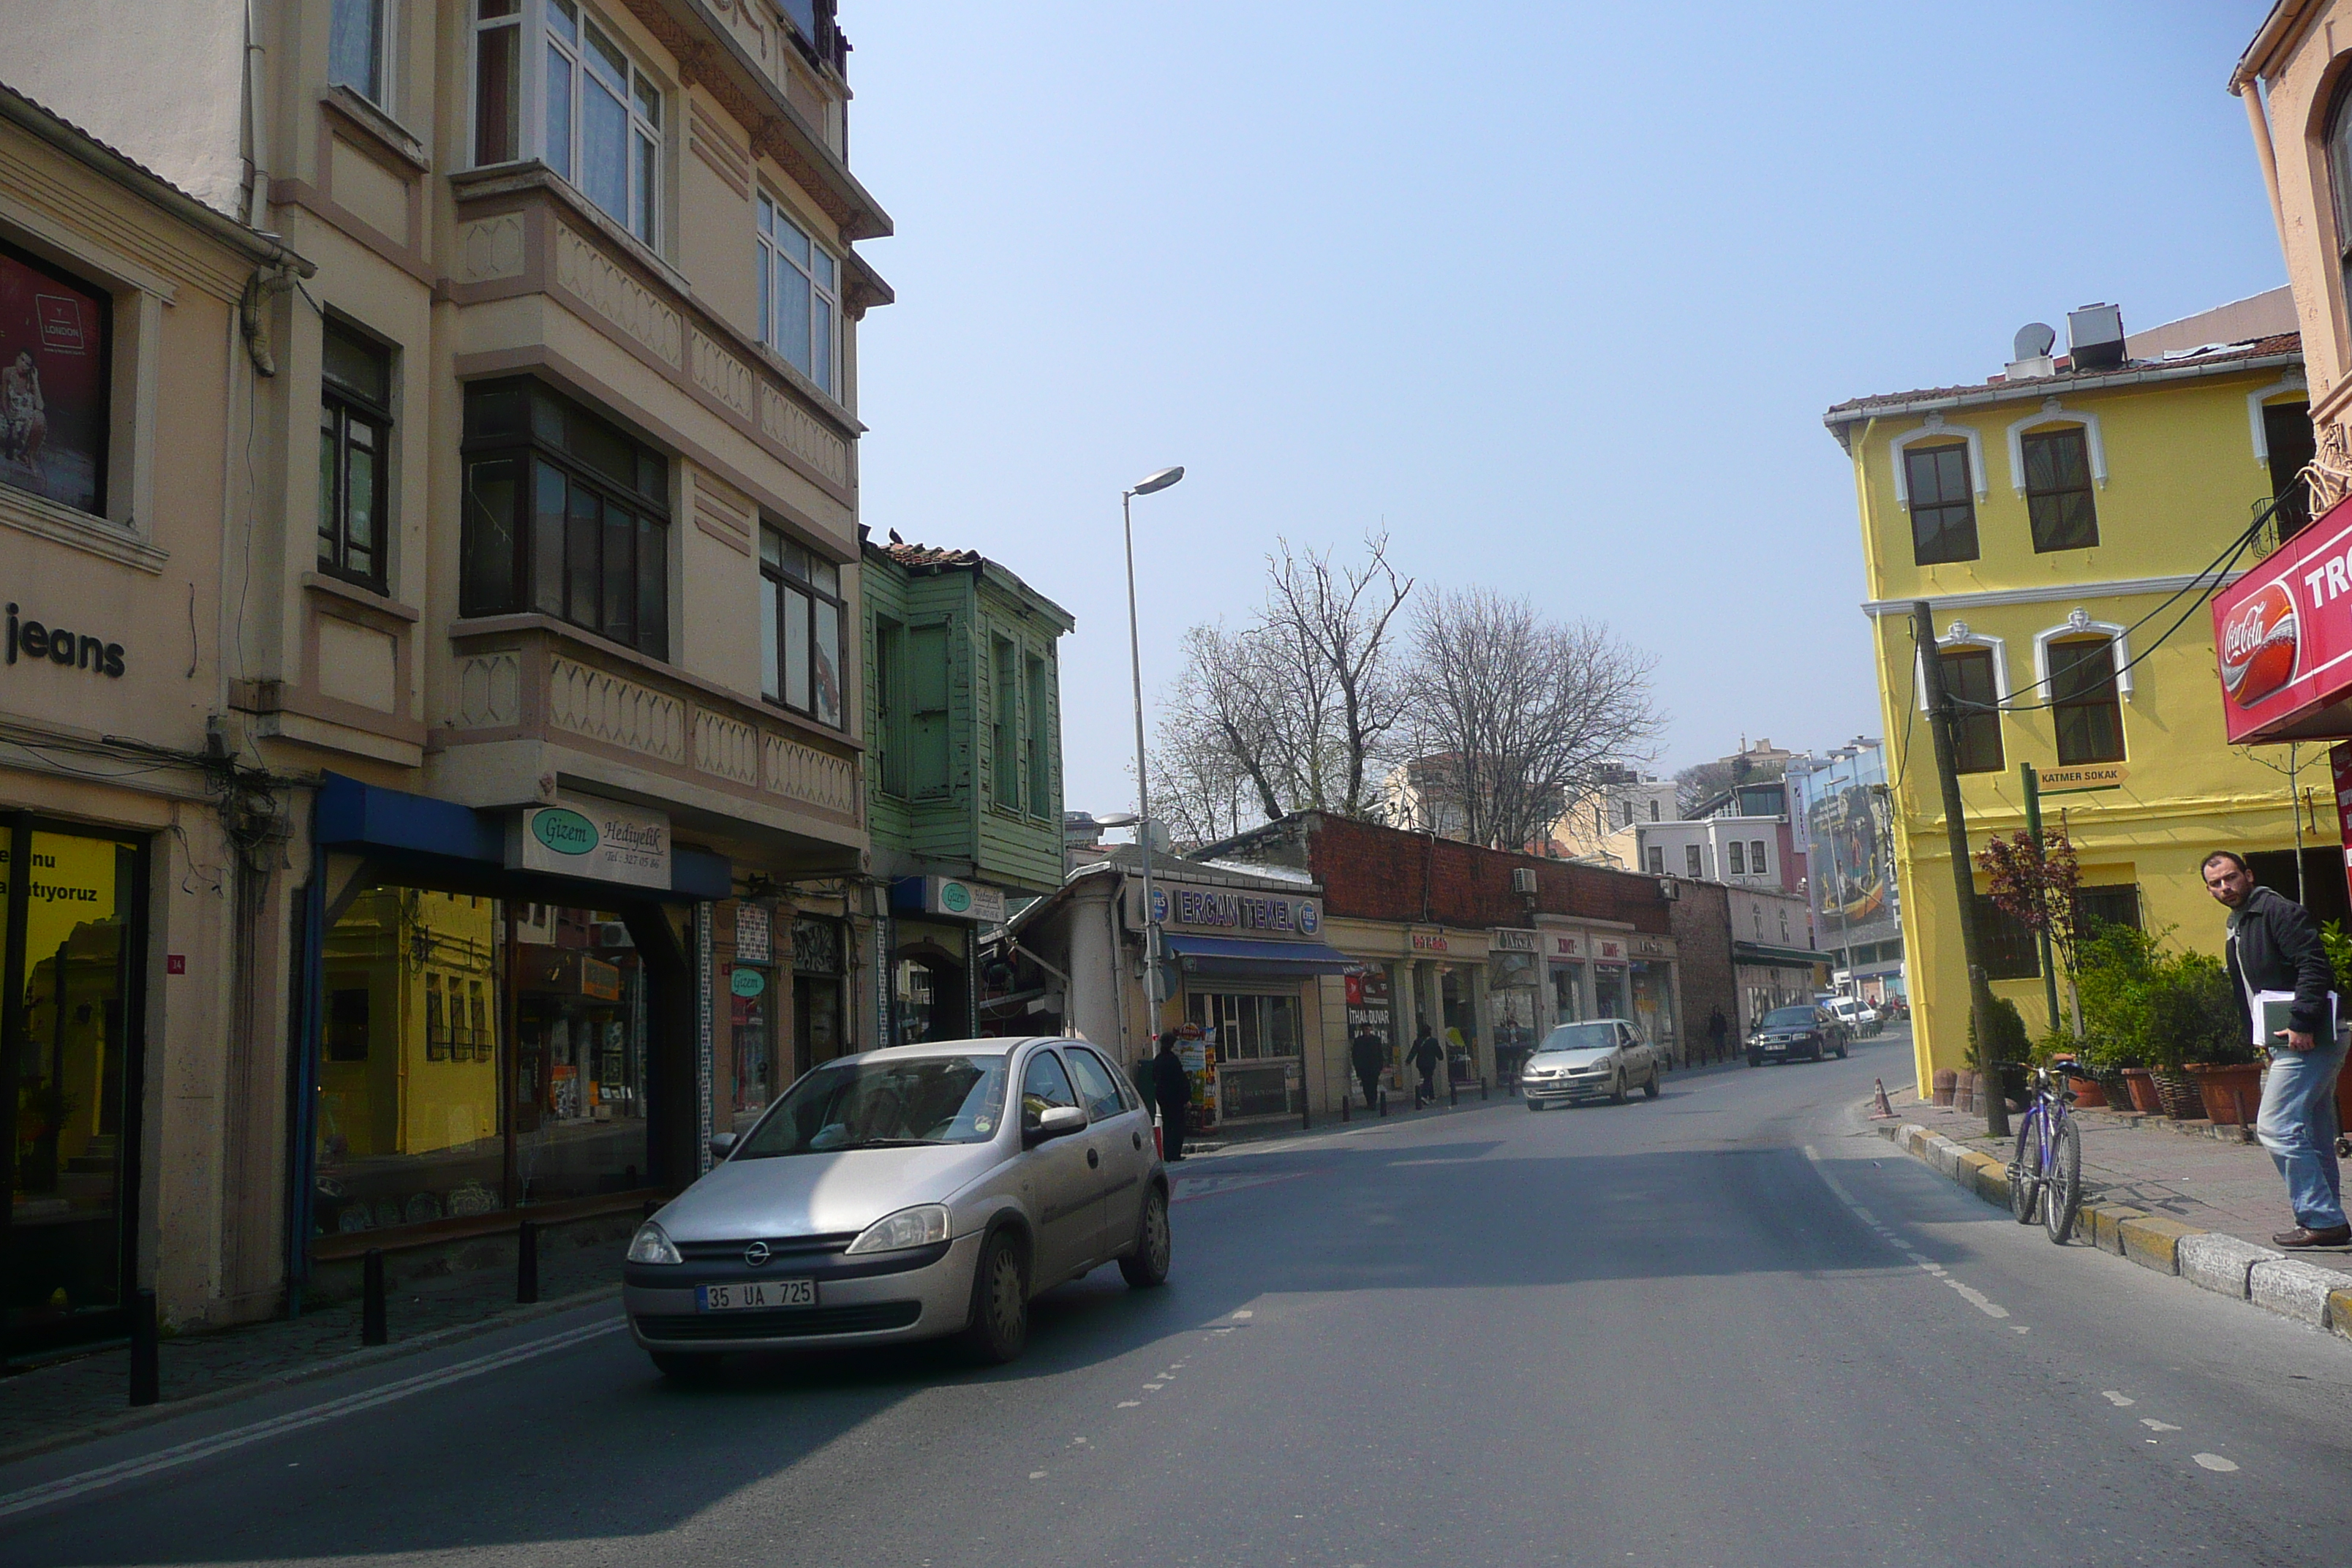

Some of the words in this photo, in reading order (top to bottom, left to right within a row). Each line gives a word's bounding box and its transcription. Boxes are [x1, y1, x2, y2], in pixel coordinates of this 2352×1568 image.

[45, 325, 79, 337] LONDON
[7, 602, 124, 677] jeans
[2042, 772, 2081, 783] KATMER
[2084, 770, 2117, 780] SOKAK
[546, 817, 587, 843] Gizem
[603, 821, 664, 853] Hediyelik
[623, 854, 637, 864] 327
[639, 858, 649, 867] 05
[649, 859, 659, 869] 86
[1153, 896, 1166, 907] FES
[1180, 890, 1239, 927] ERCAN
[1243, 896, 1294, 931] TEKEL
[1303, 911, 1316, 921] EFES
[1368, 1010, 1390, 1024] DUVAR
[709, 1287, 729, 1308] 35
[745, 1285, 765, 1305] UA
[780, 1282, 811, 1303] 725
